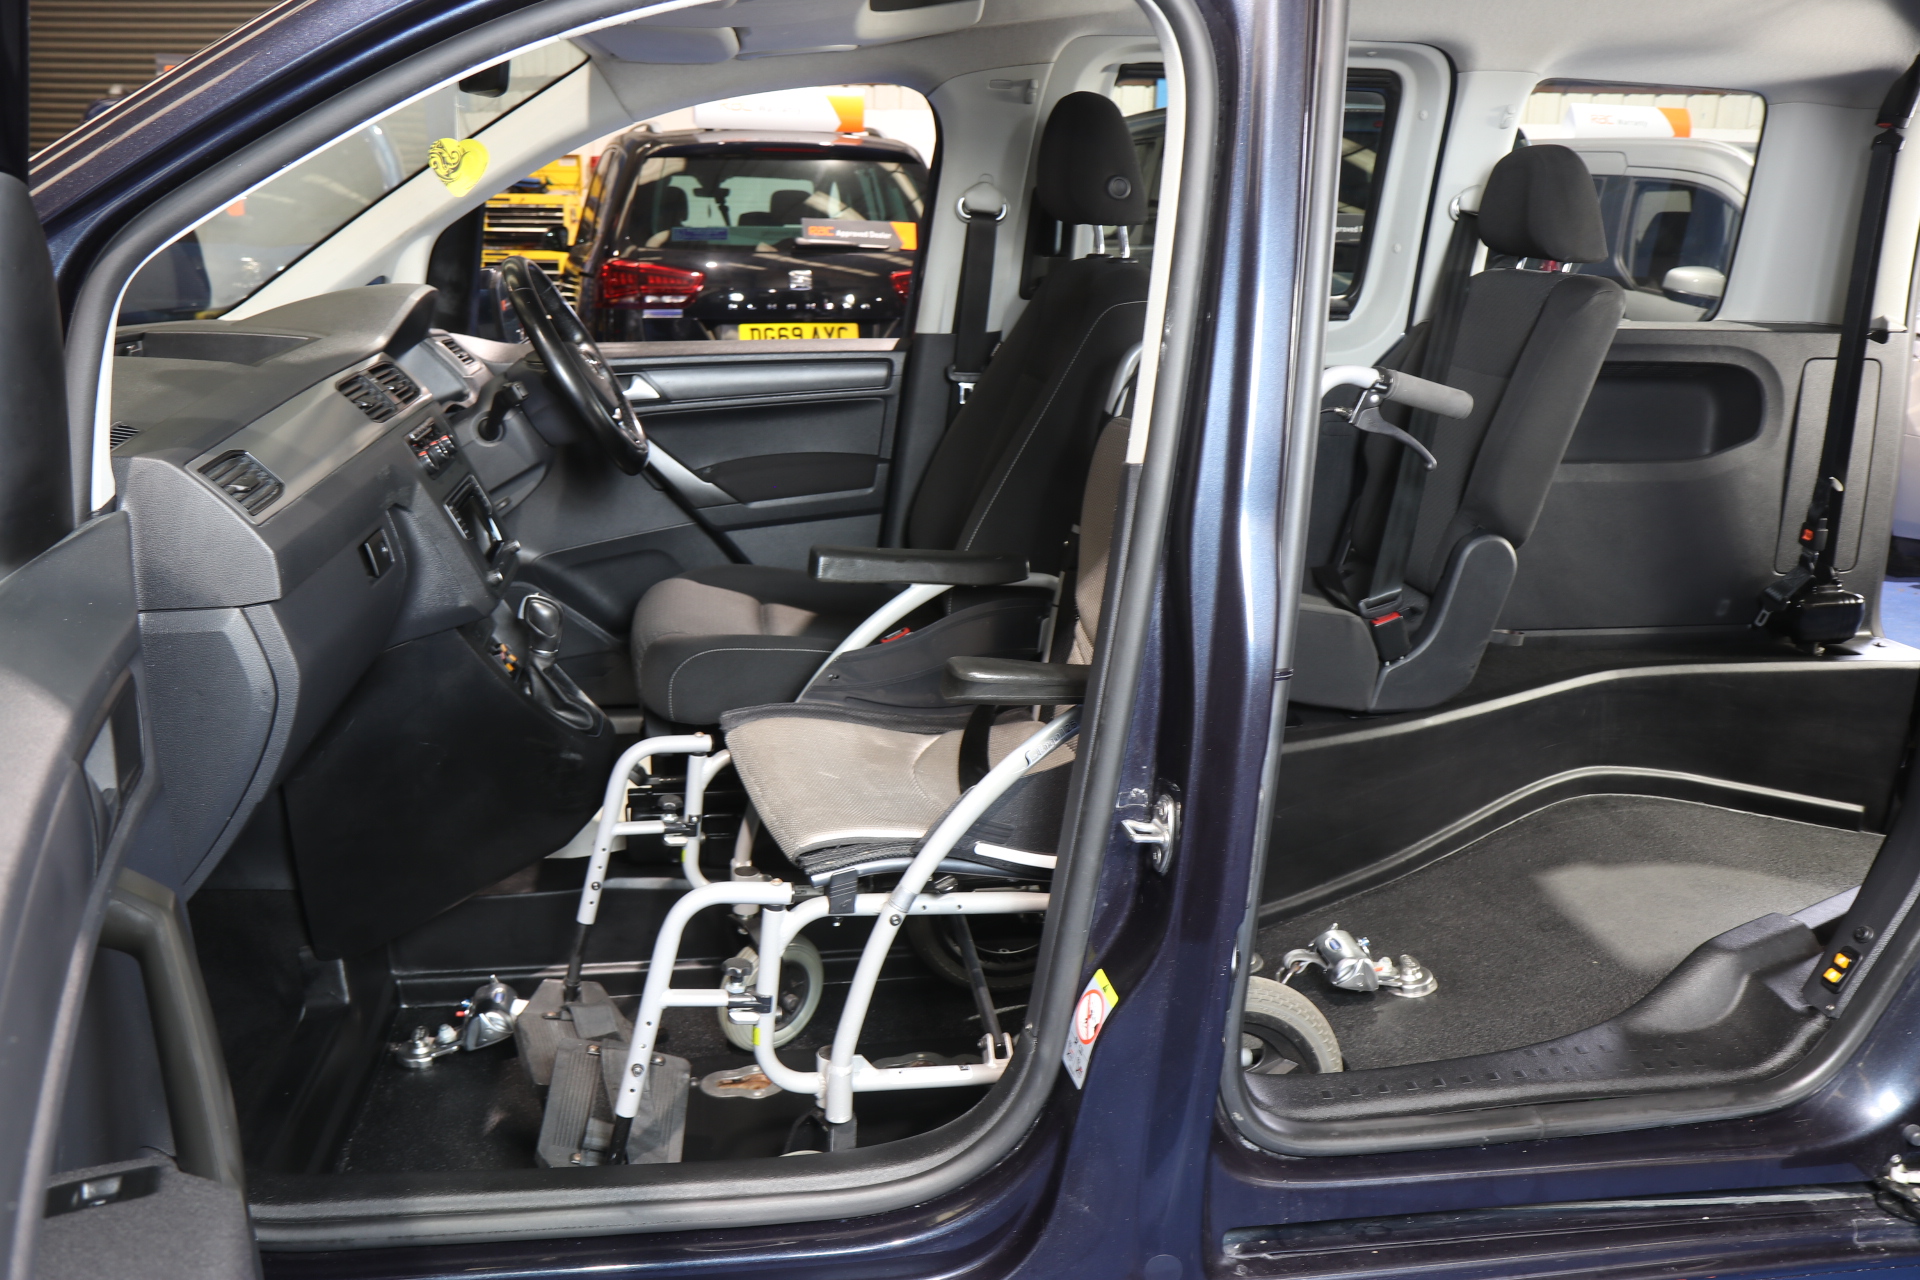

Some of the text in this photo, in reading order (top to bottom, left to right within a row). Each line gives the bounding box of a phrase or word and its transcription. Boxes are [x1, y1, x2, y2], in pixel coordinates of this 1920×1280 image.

[835, 229, 869, 239] Approved
[869, 230, 892, 240] Dealer
[750, 327, 803, 339] DG69
